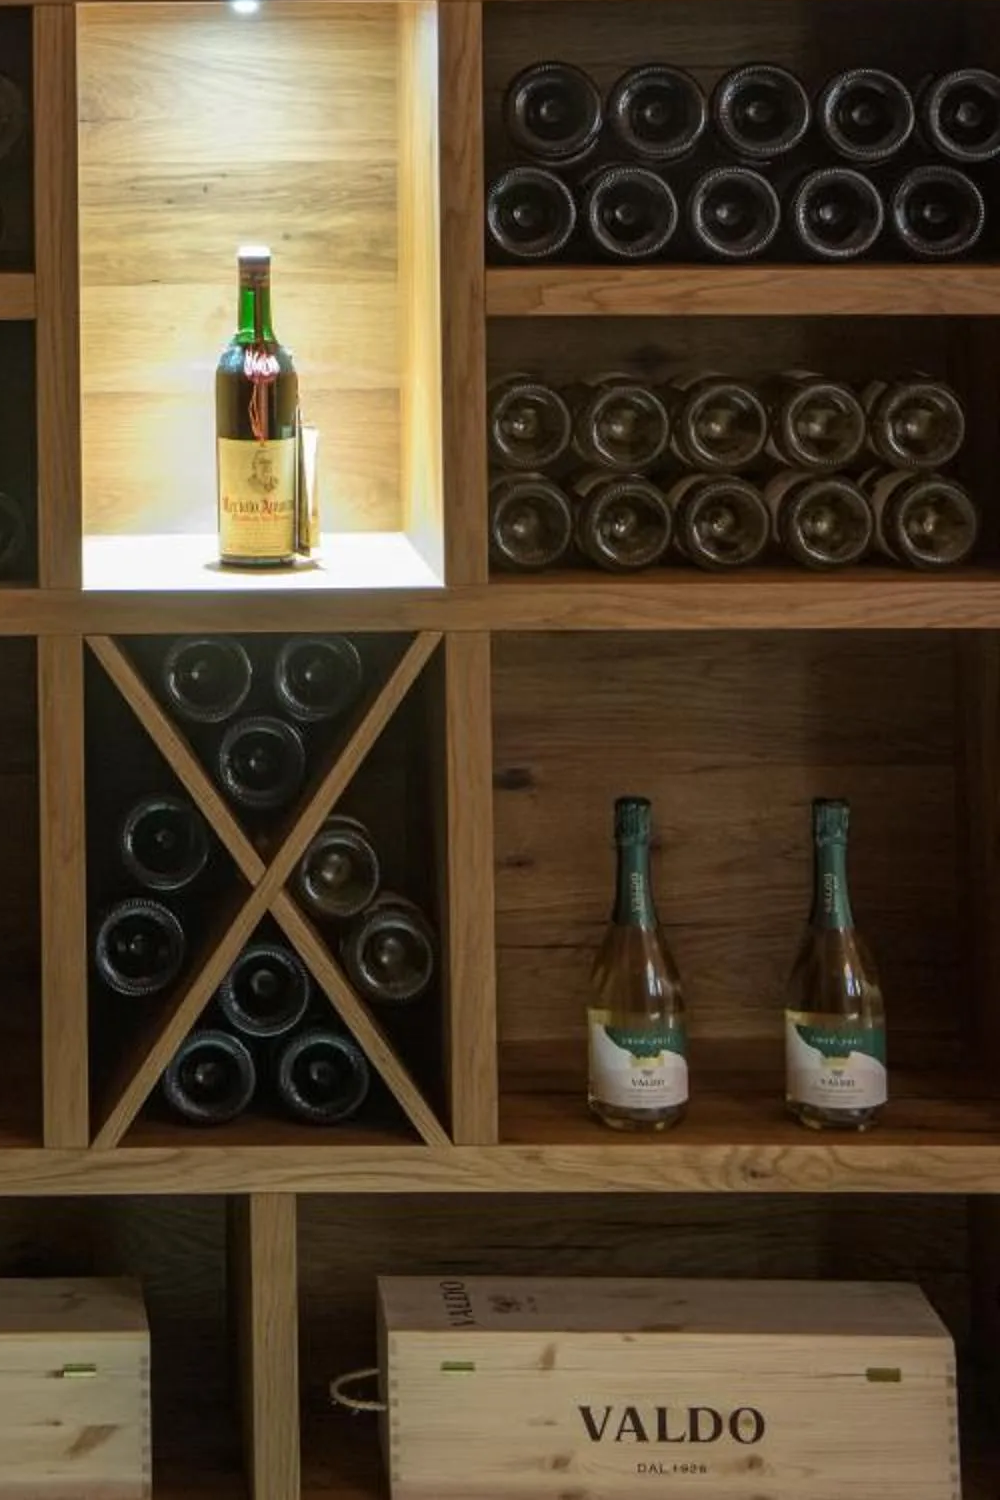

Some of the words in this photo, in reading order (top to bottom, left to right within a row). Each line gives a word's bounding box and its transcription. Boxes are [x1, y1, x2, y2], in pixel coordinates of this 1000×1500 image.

[439, 1281, 475, 1327] VALDO
[578, 1404, 776, 1445] VALDO
[637, 1463, 668, 1475] DAL
